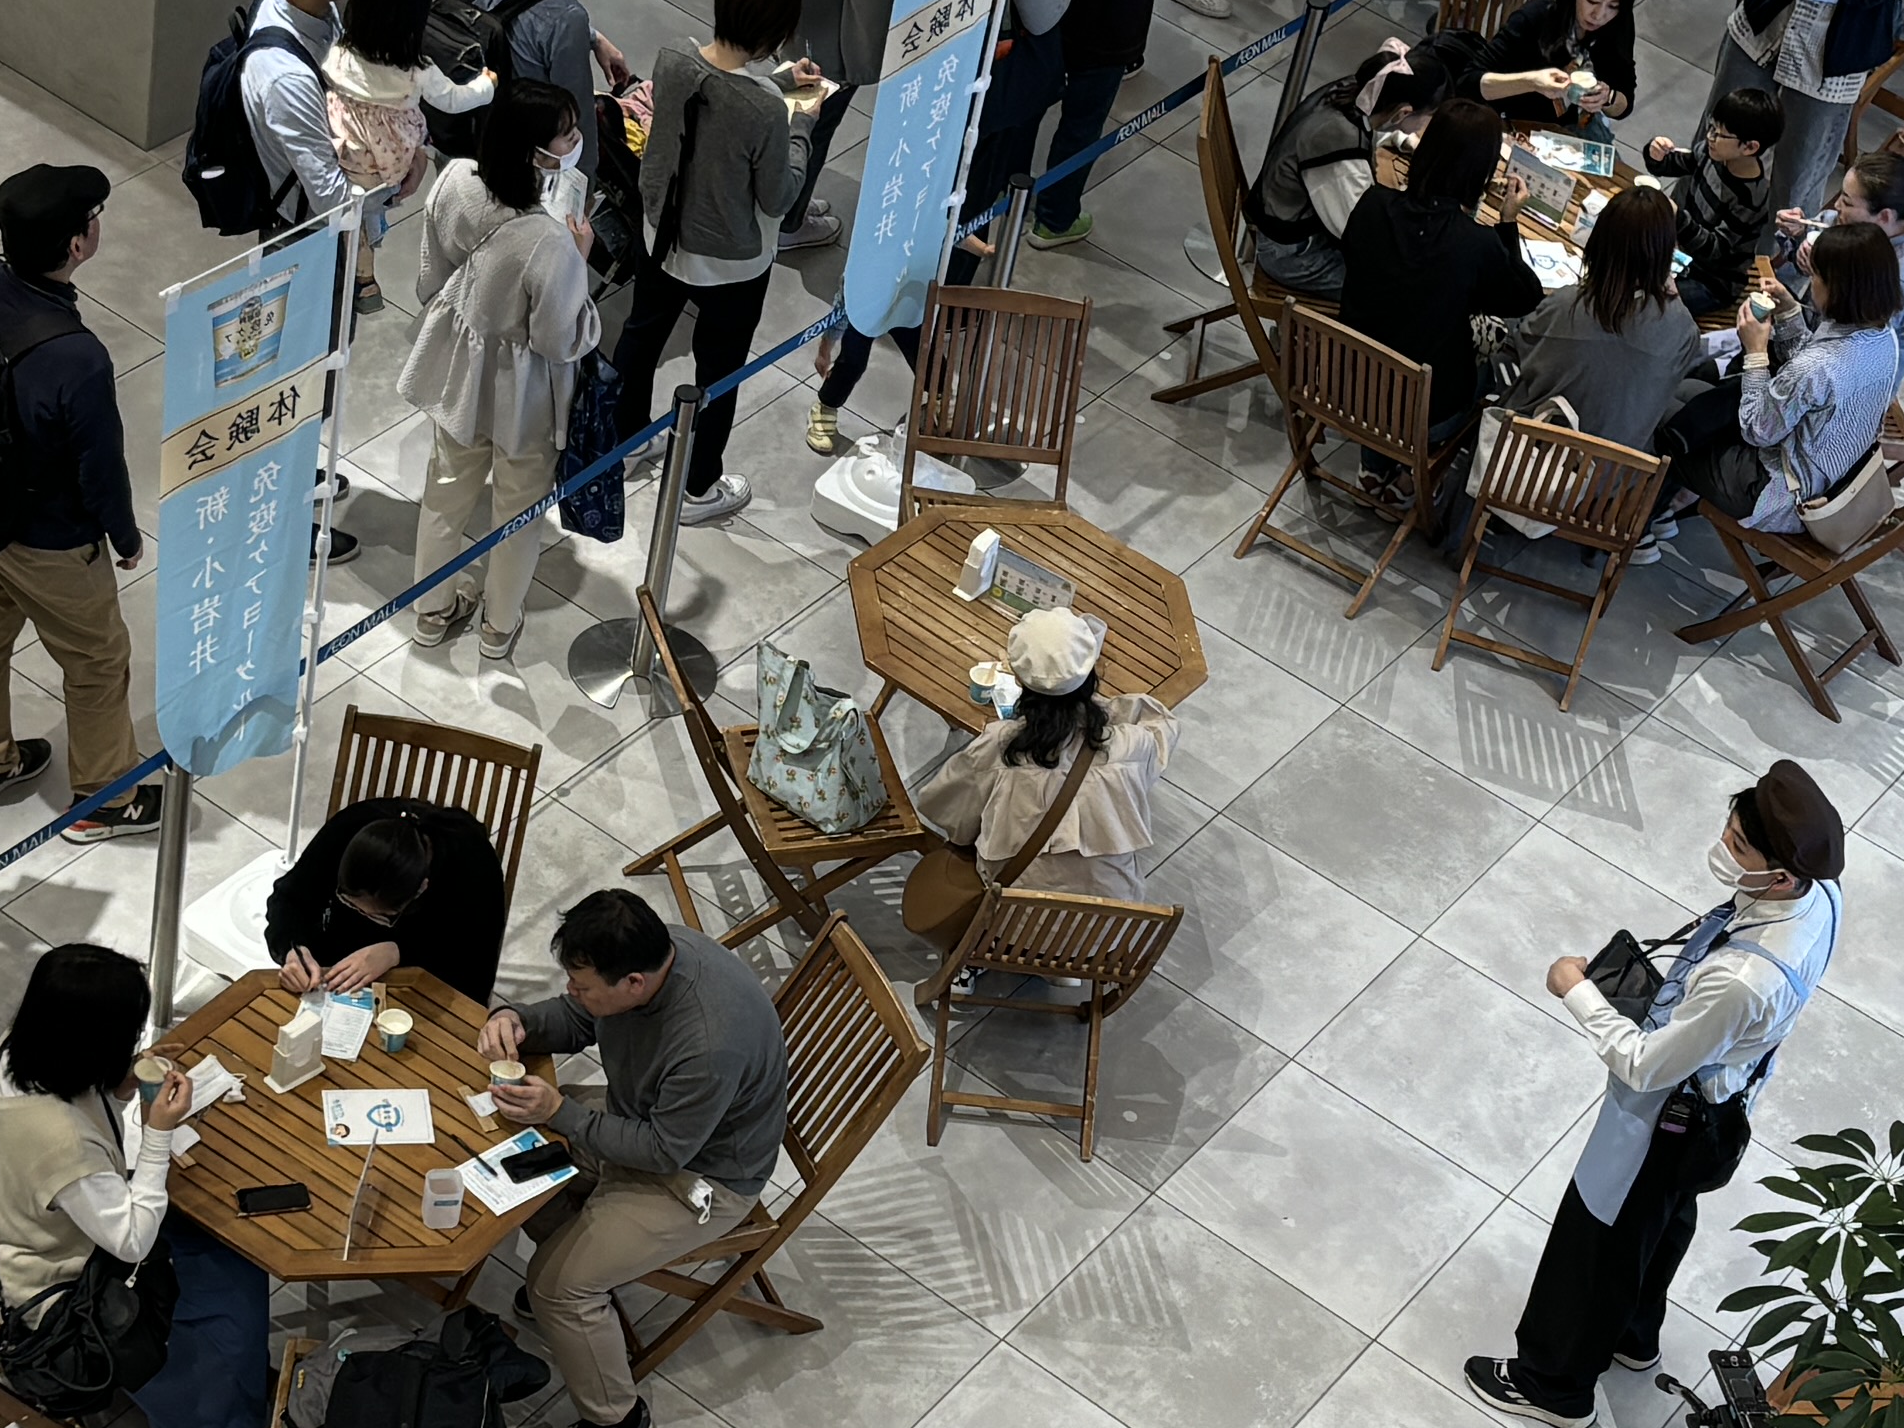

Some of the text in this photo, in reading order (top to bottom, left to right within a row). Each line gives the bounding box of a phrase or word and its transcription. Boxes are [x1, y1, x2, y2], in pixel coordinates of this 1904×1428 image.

[1260, 26, 1287, 54] MALL
[1139, 101, 1167, 128] MALL
[533, 486, 569, 520] MALL
[362, 601, 399, 634] MALL
[10, 826, 57, 863] MALL
